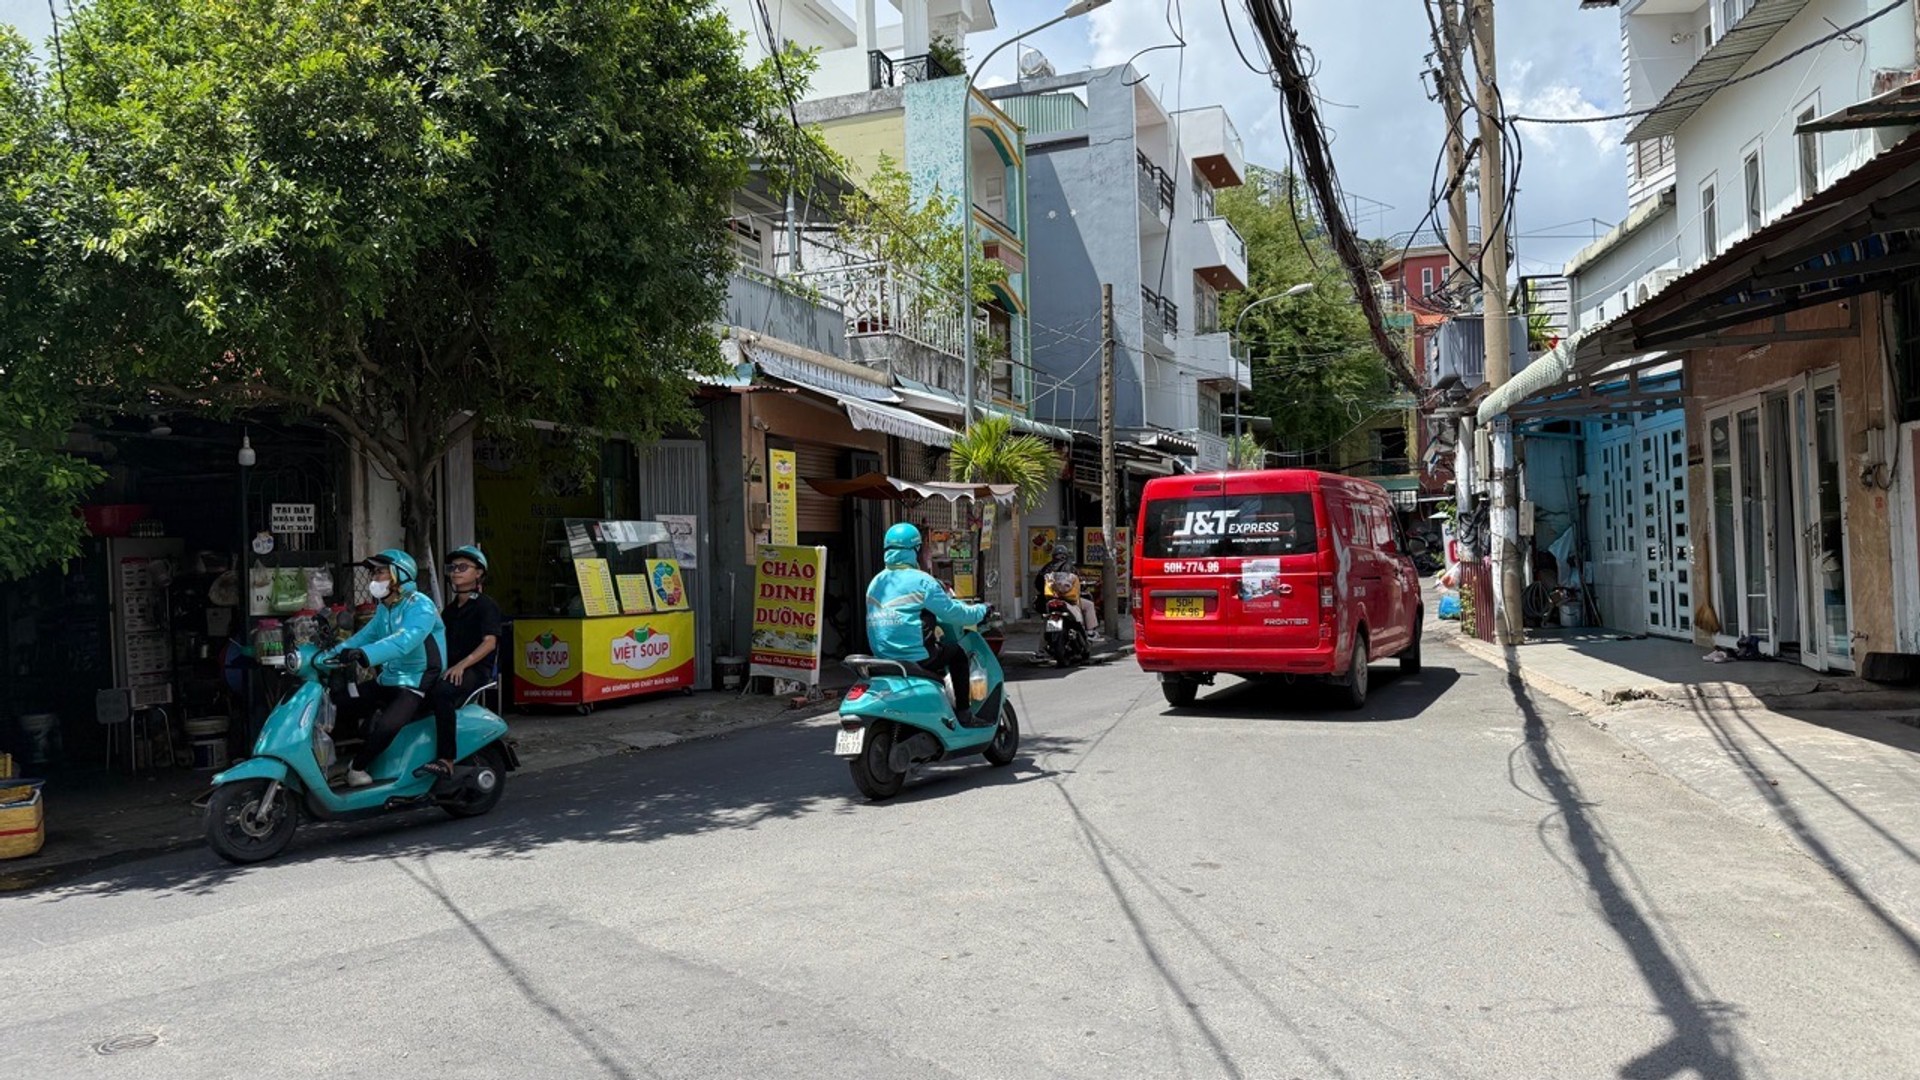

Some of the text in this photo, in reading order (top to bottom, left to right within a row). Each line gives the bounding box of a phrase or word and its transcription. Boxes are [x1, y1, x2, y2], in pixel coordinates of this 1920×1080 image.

[1173, 510, 1279, 536] J&T EXPRESS
[1164, 562, 1219, 573] 50H-774.96
[759, 583, 816, 602] DINH
[756, 606, 816, 627] DƯỠNG
[527, 647, 569, 668] VIỆT SOUP
[613, 642, 669, 662] VIỆT SOUP
